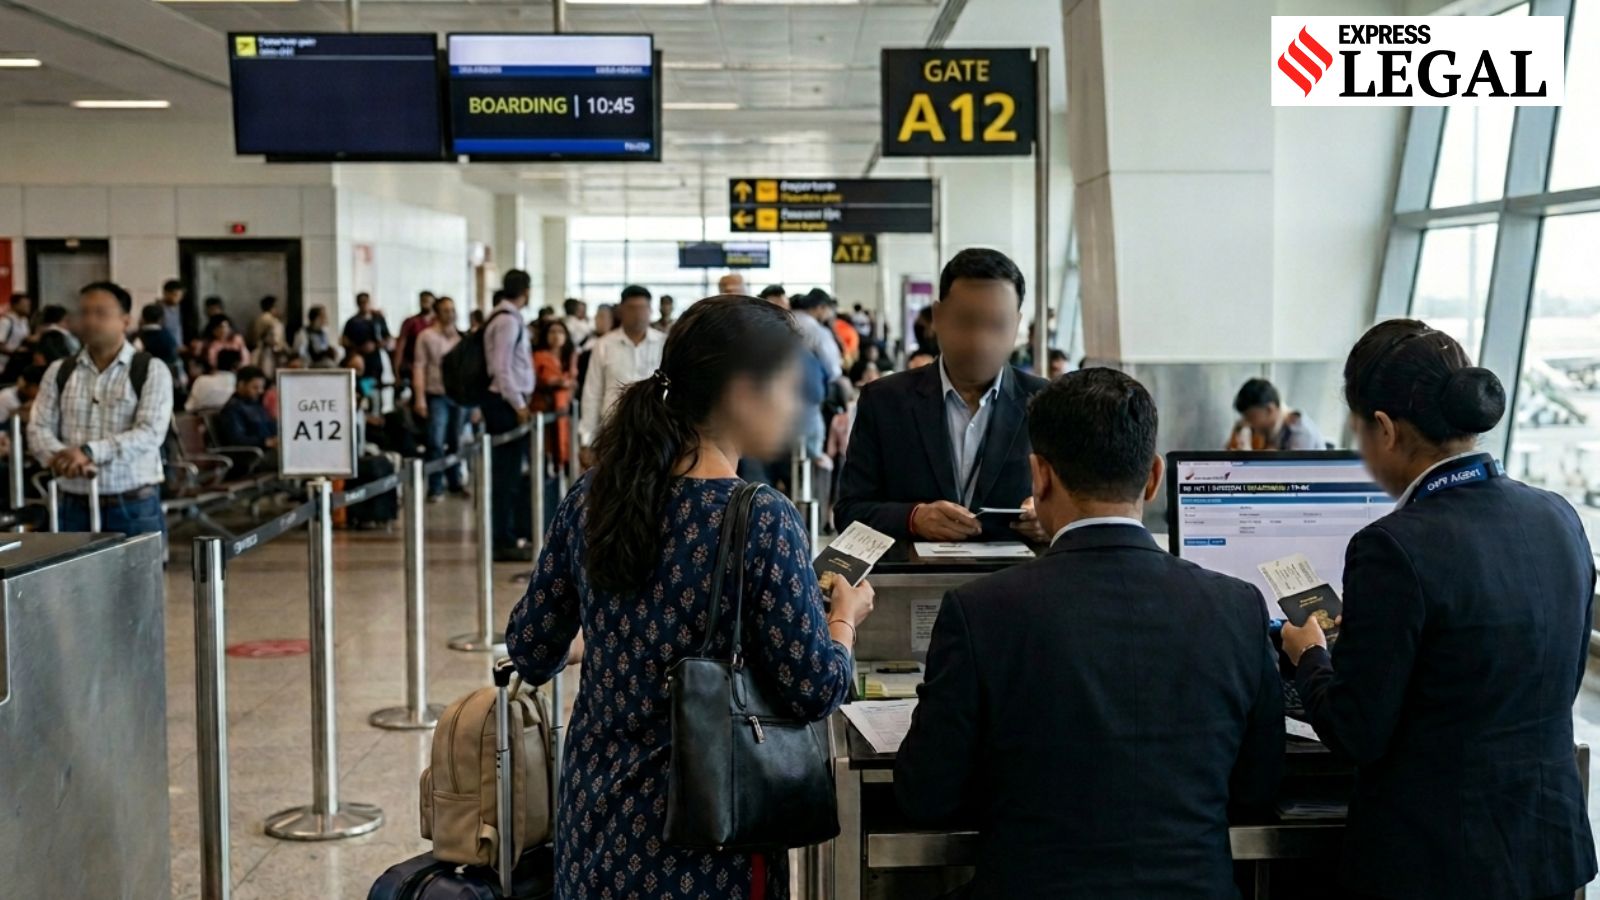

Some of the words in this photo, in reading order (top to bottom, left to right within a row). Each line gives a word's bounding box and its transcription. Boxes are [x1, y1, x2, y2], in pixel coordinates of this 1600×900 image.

[923, 59, 991, 83] GATE
[468, 96, 568, 115] BOARDING
[586, 96, 636, 115] 10:45
[897, 92, 1018, 143] A12
[297, 399, 338, 413] GATE
[292, 419, 343, 441] A12
